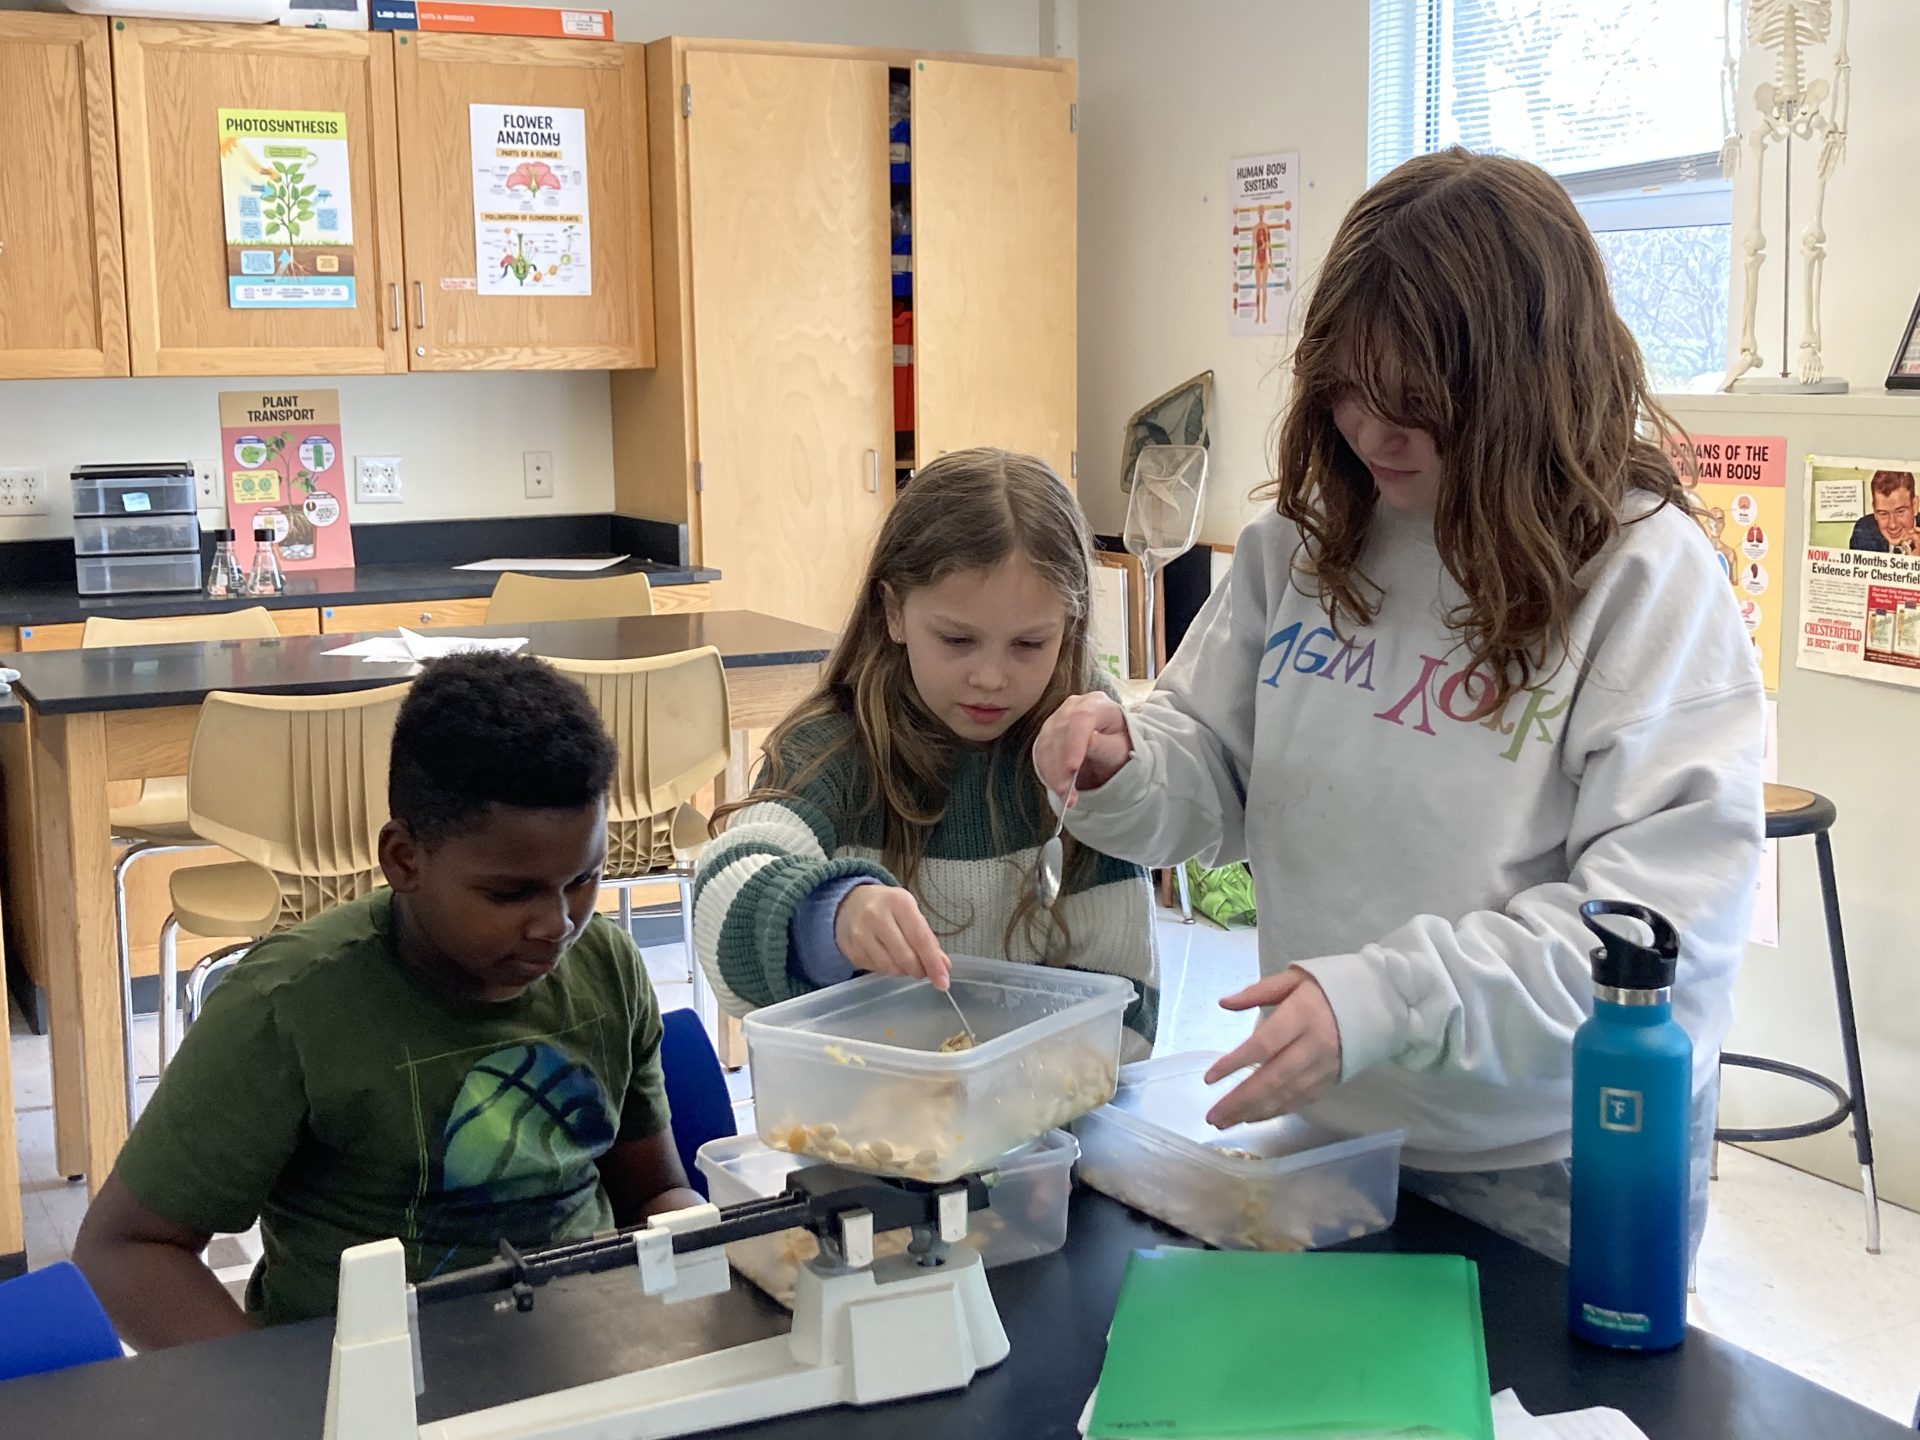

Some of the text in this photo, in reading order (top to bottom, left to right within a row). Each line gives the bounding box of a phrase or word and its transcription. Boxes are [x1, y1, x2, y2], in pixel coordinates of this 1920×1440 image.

[226, 118, 338, 134] PHOTOSYNTHESIS
[503, 114, 553, 130] FLOWER
[497, 131, 561, 147] ANATOMY
[1237, 162, 1286, 179] HUMAN BODY
[1244, 177, 1278, 192] SYSTEMS
[262, 395, 299, 408] PLANT
[247, 408, 315, 422] TRANSPORT
[1725, 445, 1741, 461] OF
[1746, 446, 1769, 462] THE
[1727, 463, 1761, 480] BODY
[1853, 553, 1888, 568] Months
[1812, 562, 1851, 577] Evidence
[1853, 567, 1869, 579] For
[1804, 622, 1862, 641] CHESTERFIELD
[1807, 637, 1814, 646] IS
[1814, 638, 1831, 650] BEST
[1846, 642, 1859, 654] YOU
